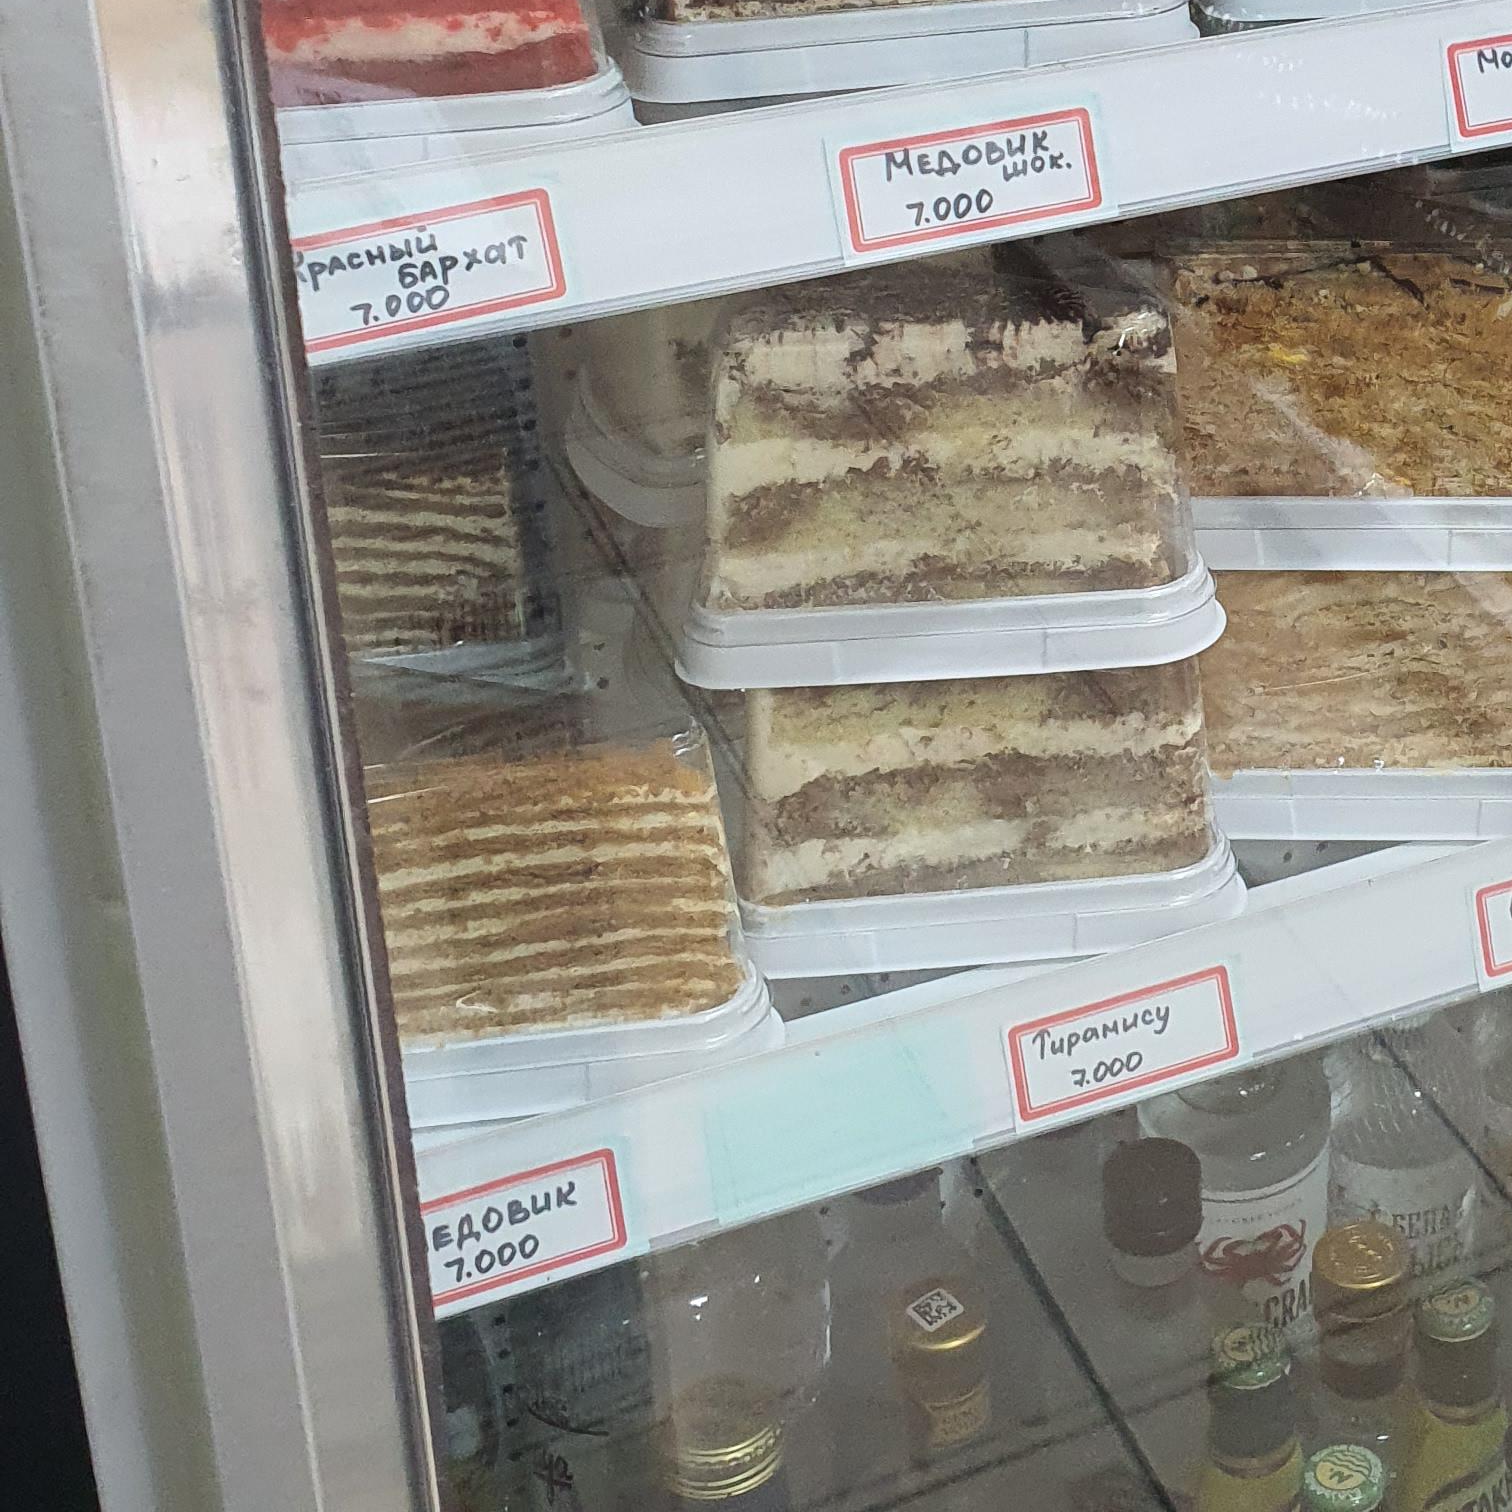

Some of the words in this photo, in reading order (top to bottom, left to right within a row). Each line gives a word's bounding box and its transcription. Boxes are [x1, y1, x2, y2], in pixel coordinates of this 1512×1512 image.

[905, 188, 993, 226] 7.000
[350, 284, 450, 326] 7.000
[1032, 1005, 1170, 1060] Тирамису
[1070, 1051, 1143, 1088] 7.000
[431, 1181, 578, 1252] ЕДОВИК
[444, 1234, 540, 1283] 7.000
